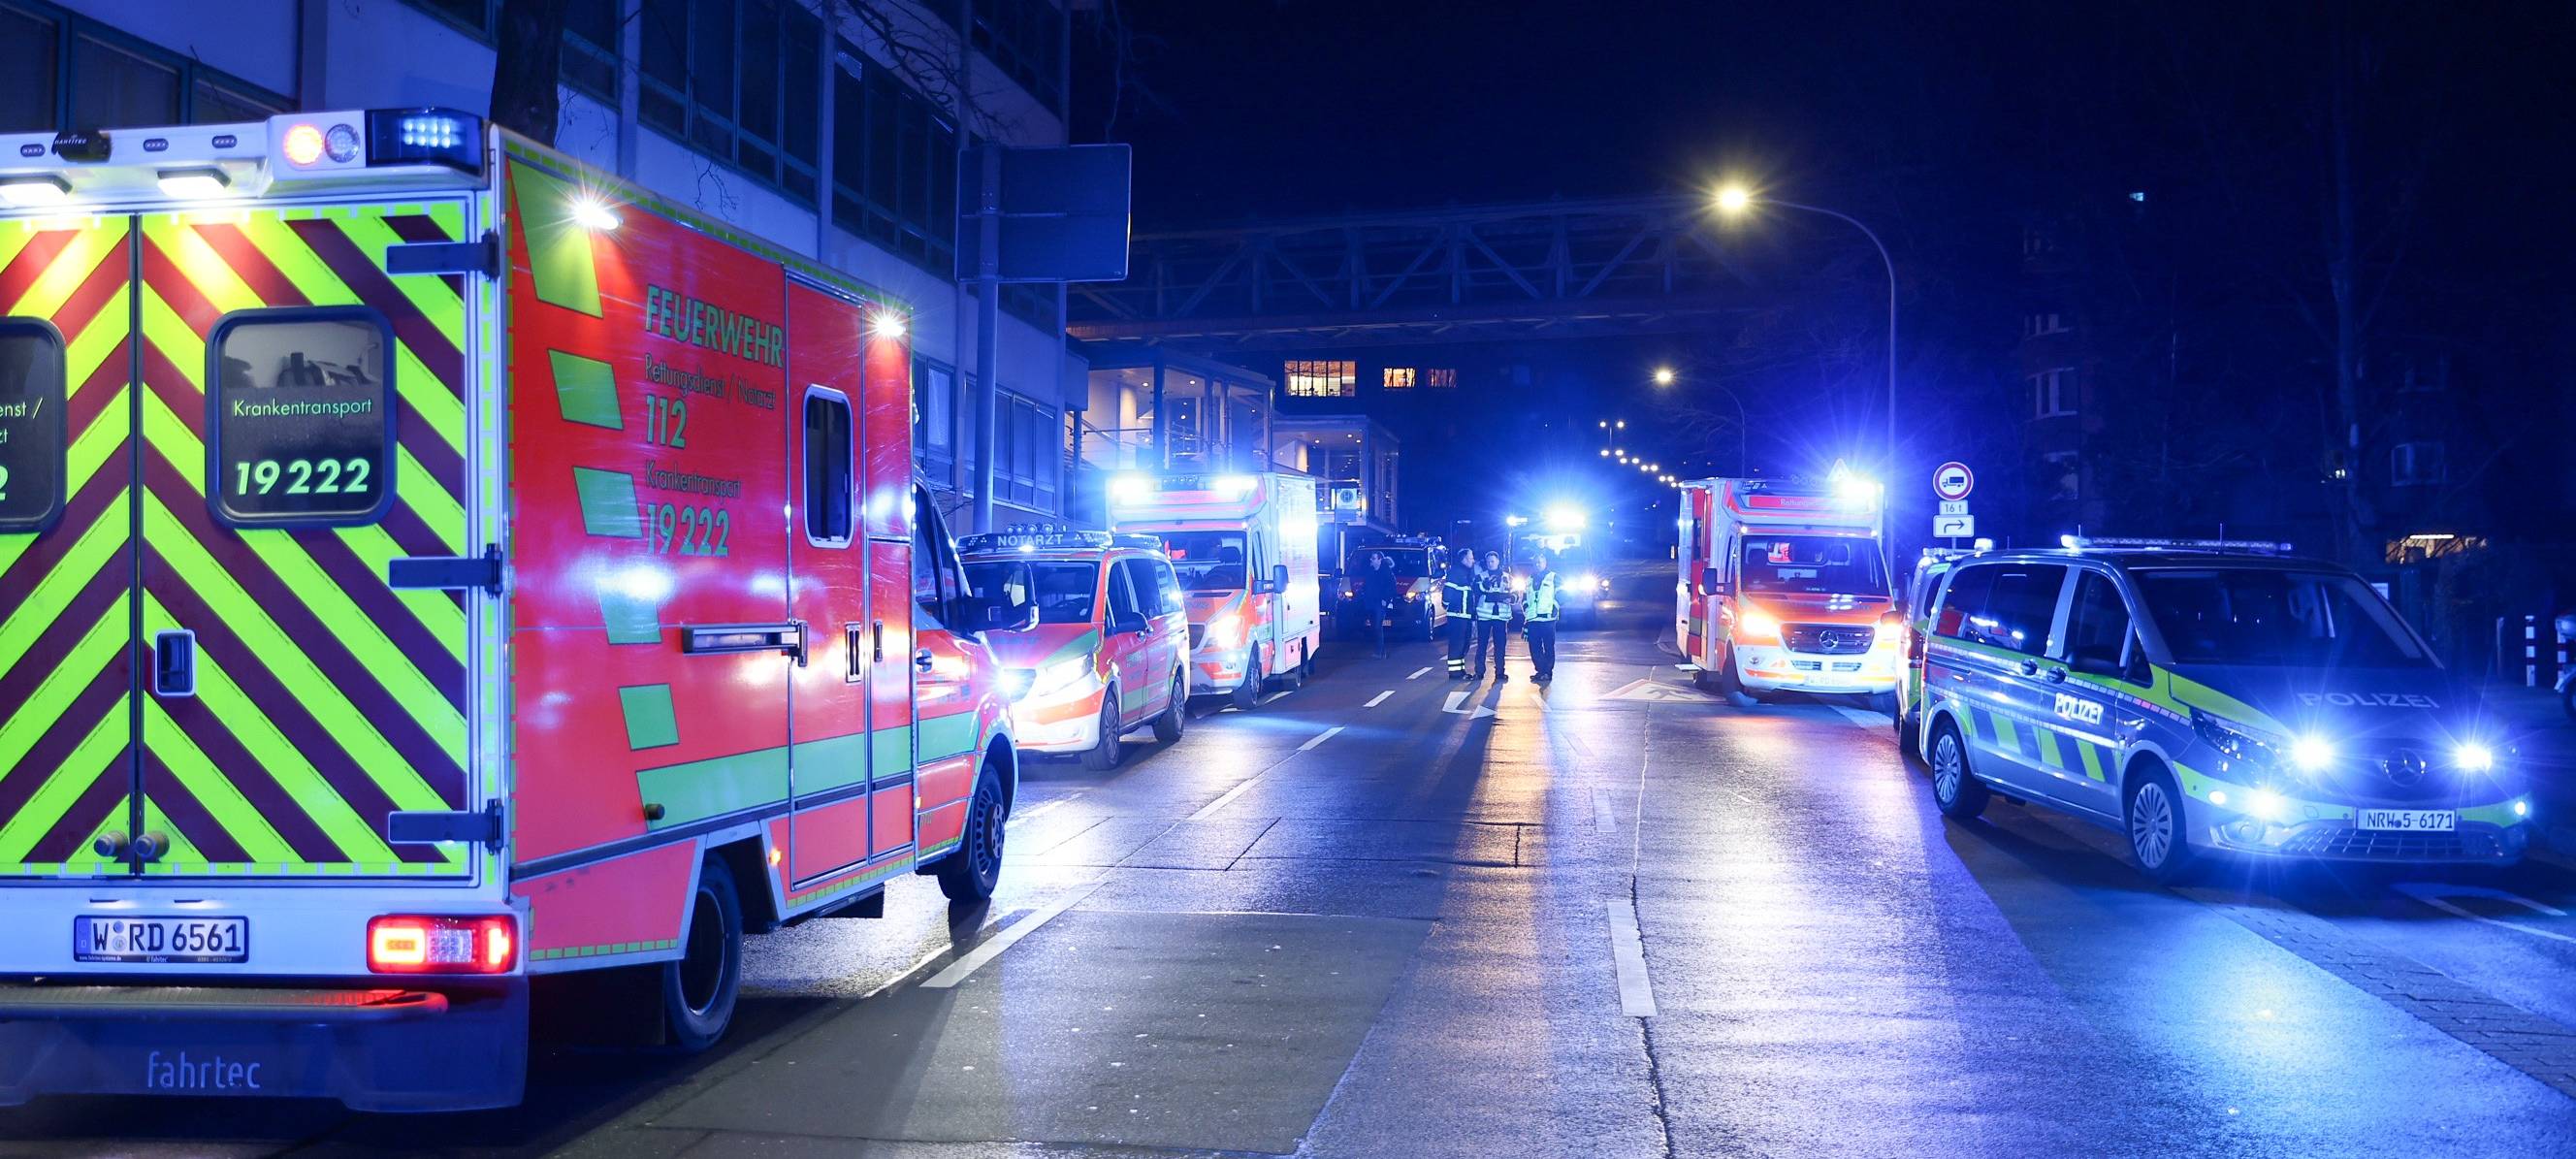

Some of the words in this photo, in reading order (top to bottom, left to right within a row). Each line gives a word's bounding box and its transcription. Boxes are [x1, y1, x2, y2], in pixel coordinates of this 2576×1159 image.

[646, 284, 785, 370] FEUERWEHR
[233, 398, 372, 419] Krankentransport
[646, 394, 688, 450] 112
[1945, 503, 1955, 513] 16
[997, 533, 1064, 547] NOTARZT
[2054, 692, 2105, 725] POLIZEI
[2297, 692, 2441, 709] POLIZEI
[172, 922, 242, 952] 6561
[147, 1050, 261, 1088] fahrtec
